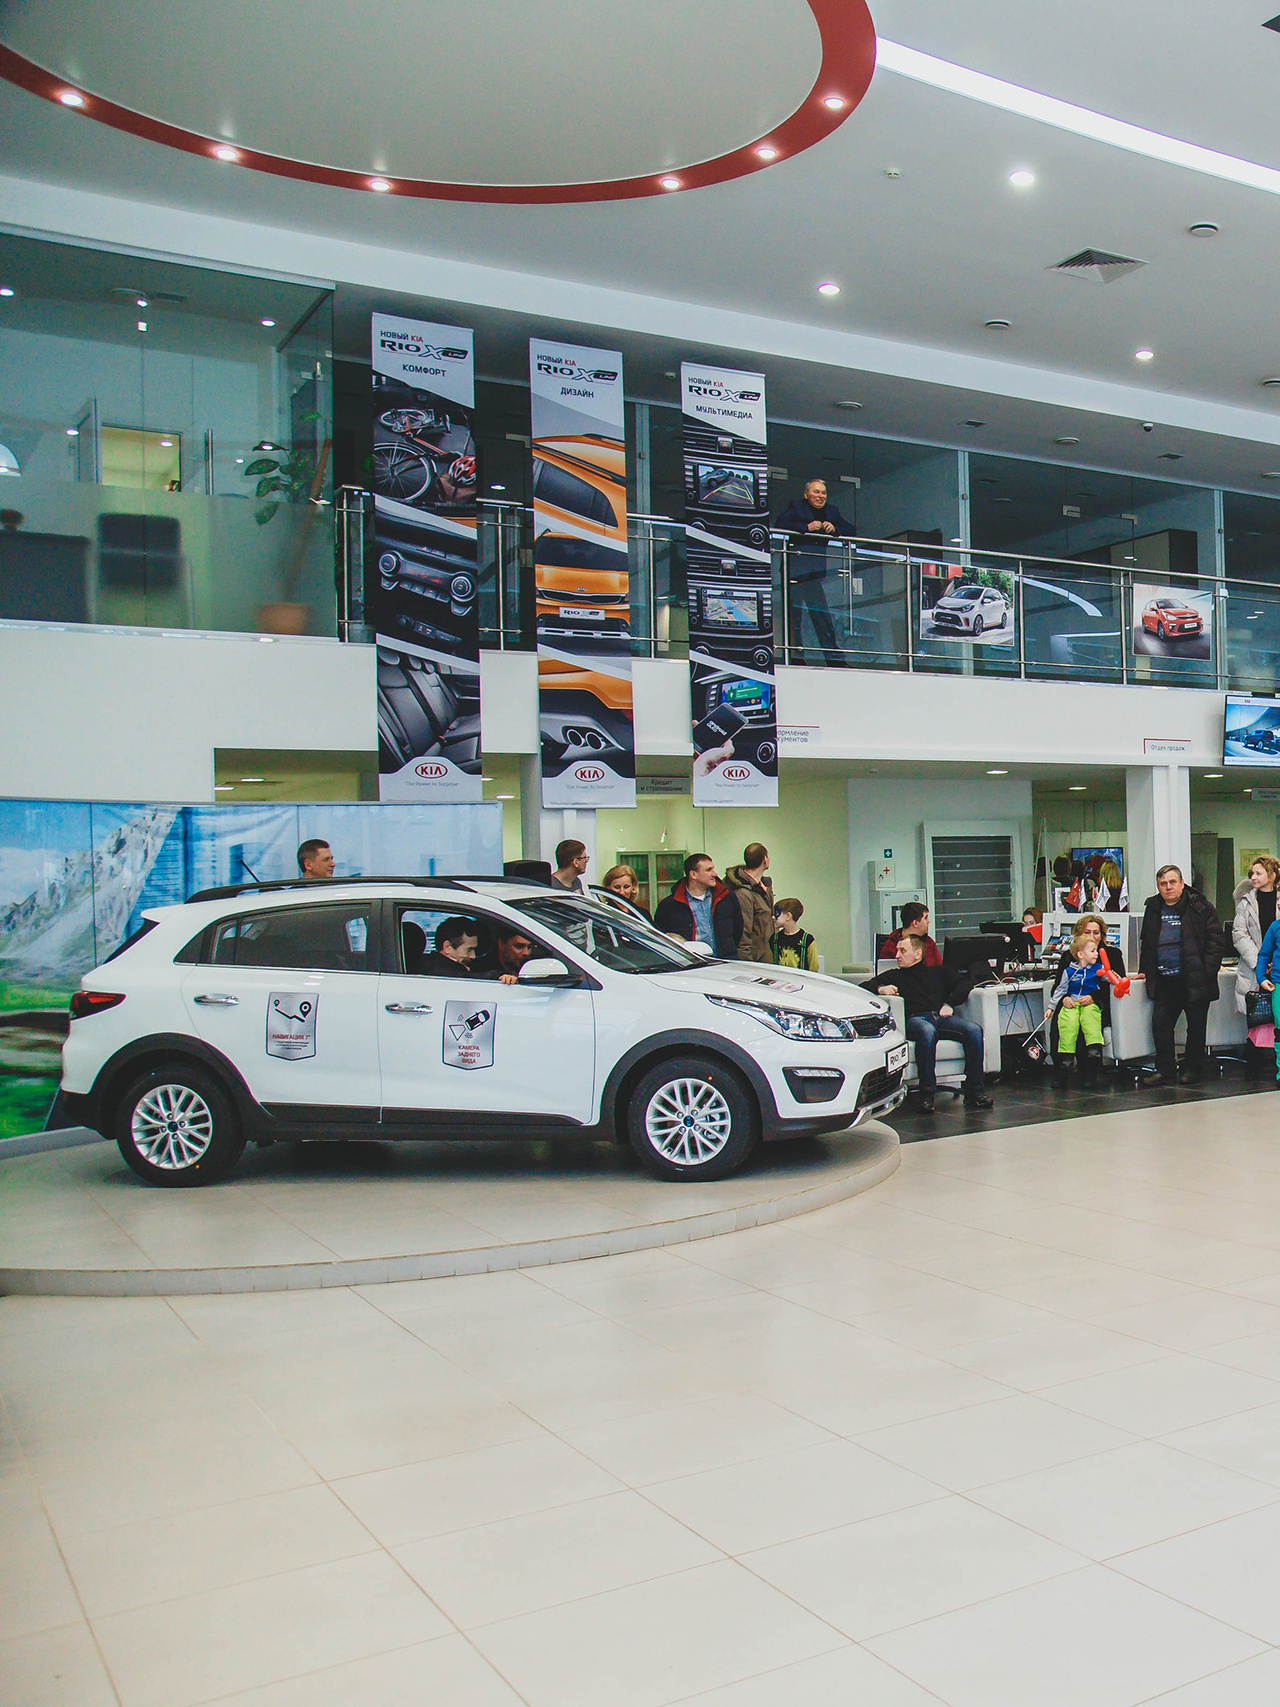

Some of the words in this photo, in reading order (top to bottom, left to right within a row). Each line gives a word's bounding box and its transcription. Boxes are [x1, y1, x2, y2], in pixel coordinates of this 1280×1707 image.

[380, 331, 409, 340] НОВЫЙ
[380, 339, 422, 352] RIO
[537, 354, 563, 364] НОВЫЙ
[564, 359, 577, 367] KIA
[402, 364, 446, 377] КОМФОРТ
[537, 362, 574, 376] RIO
[688, 377, 712, 386] НОВЫЙ
[560, 386, 595, 398] ДИЗАЙН
[688, 385, 722, 396] RIO
[695, 405, 753, 420] МУЛЬТИМЕДИА
[420, 766, 443, 775] KIA
[580, 769, 600, 779] KIA
[727, 769, 746, 778] KIA
